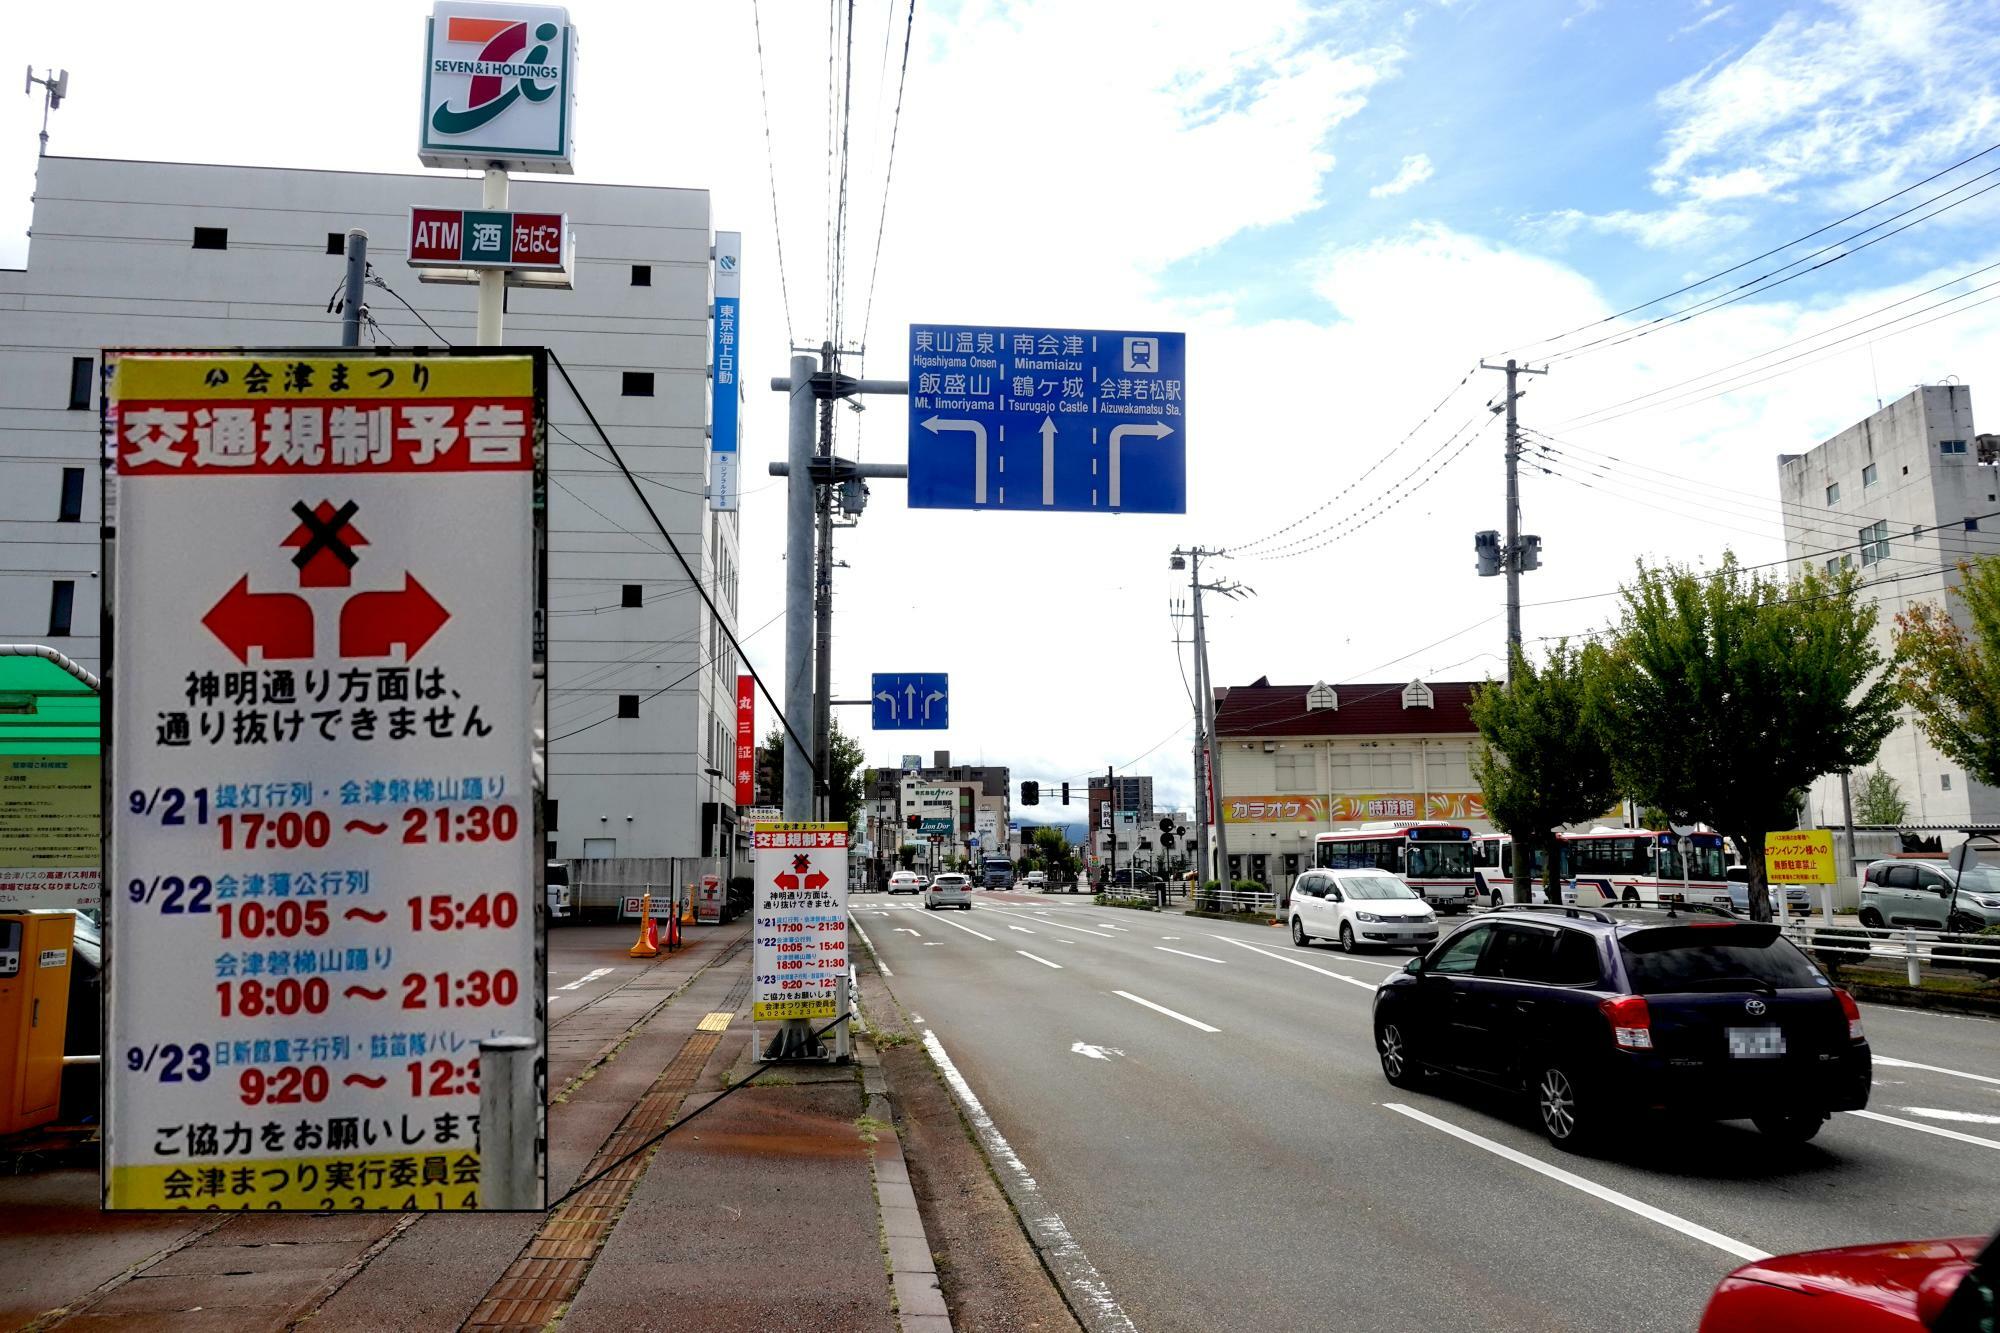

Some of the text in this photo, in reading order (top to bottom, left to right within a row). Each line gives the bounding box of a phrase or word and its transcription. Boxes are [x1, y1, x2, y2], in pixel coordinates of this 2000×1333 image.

[492, 63, 558, 78] HOLDINGS
[415, 221, 559, 253] ATM 酒 たばこ
[719, 305, 734, 384] 東京海上日動
[915, 331, 995, 353] 東山温泉
[1013, 334, 1084, 356] 南会津
[913, 356, 997, 368] Higashiyama Onsen
[1014, 358, 1082, 371] Minamiaizu
[918, 372, 991, 395] 飯盛山
[1100, 378, 1181, 401] 会津若松駅
[915, 398, 995, 411] Mt. Iimoriyama
[1008, 400, 1088, 413] Tsurugajo Castle
[1100, 404, 1182, 415] Aizuwakamatsu Sta.
[123, 405, 526, 468] 交通規制予告
[186, 667, 461, 706] 神明通り方面は、
[156, 706, 492, 746] 通り抜けできません
[738, 696, 752, 783] 丸三証券
[129, 787, 208, 825] 9/21
[1232, 801, 1300, 818] カラオケ
[1368, 800, 1415, 817] 時遊館
[218, 811, 330, 849] 17:00
[402, 804, 518, 844] 21:30
[756, 832, 846, 847] 交通規制予告
[129, 876, 212, 914] 9/22
[763, 900, 839, 909] 通り抜けできません
[217, 901, 329, 938] 10:05
[408, 893, 518, 931] 15:40
[757, 918, 776, 927] 9/21
[777, 923, 803, 932] 17:00
[818, 922, 844, 931] 21:30
[757, 938, 776, 947] 9/22
[777, 943, 803, 952] 10:05
[819, 941, 844, 950] 15:40
[777, 960, 803, 969] 18:00
[818, 959, 844, 968] 21:30
[757, 975, 776, 984] 9/23
[782, 980, 803, 989] 9:20
[819, 979, 837, 987] 12:3
[217, 977, 329, 1017] 18:00
[402, 969, 518, 1010] 21:30
[127, 1043, 210, 1082] 9/23
[240, 1065, 329, 1105] 9:20
[407, 1058, 480, 1098] 12:3
[164, 1154, 480, 1199] 会津まつり実行委員会
